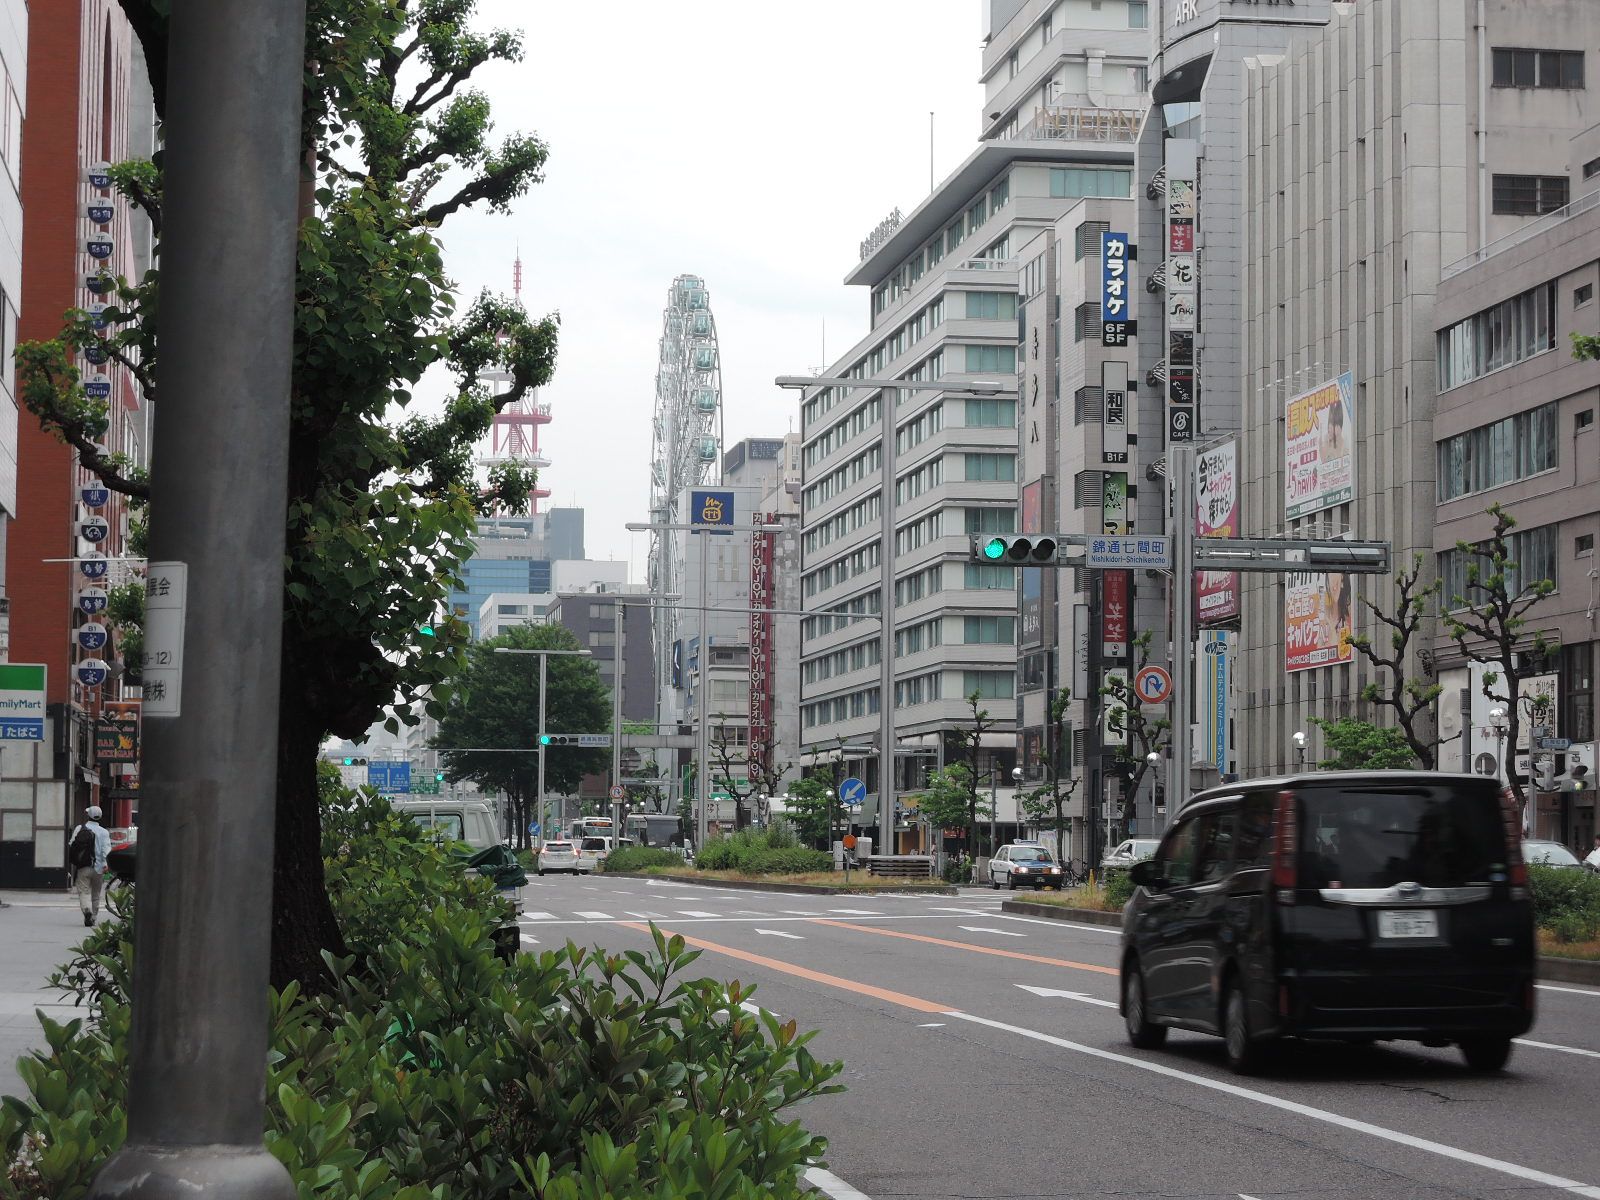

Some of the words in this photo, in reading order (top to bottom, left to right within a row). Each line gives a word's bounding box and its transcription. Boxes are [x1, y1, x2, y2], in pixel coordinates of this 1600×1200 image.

[1107, 239, 1125, 315] カラオケ
[1105, 323, 1126, 333] 6F
[1105, 333, 1126, 343] 5F
[1107, 452, 1124, 462] B1F
[1092, 540, 1165, 555] 錦通七間町
[1091, 555, 1166, 564] Nishikidori-Shichikencho
[1080, 632, 1089, 672] KATANA
[7, 726, 38, 738] たばこ
